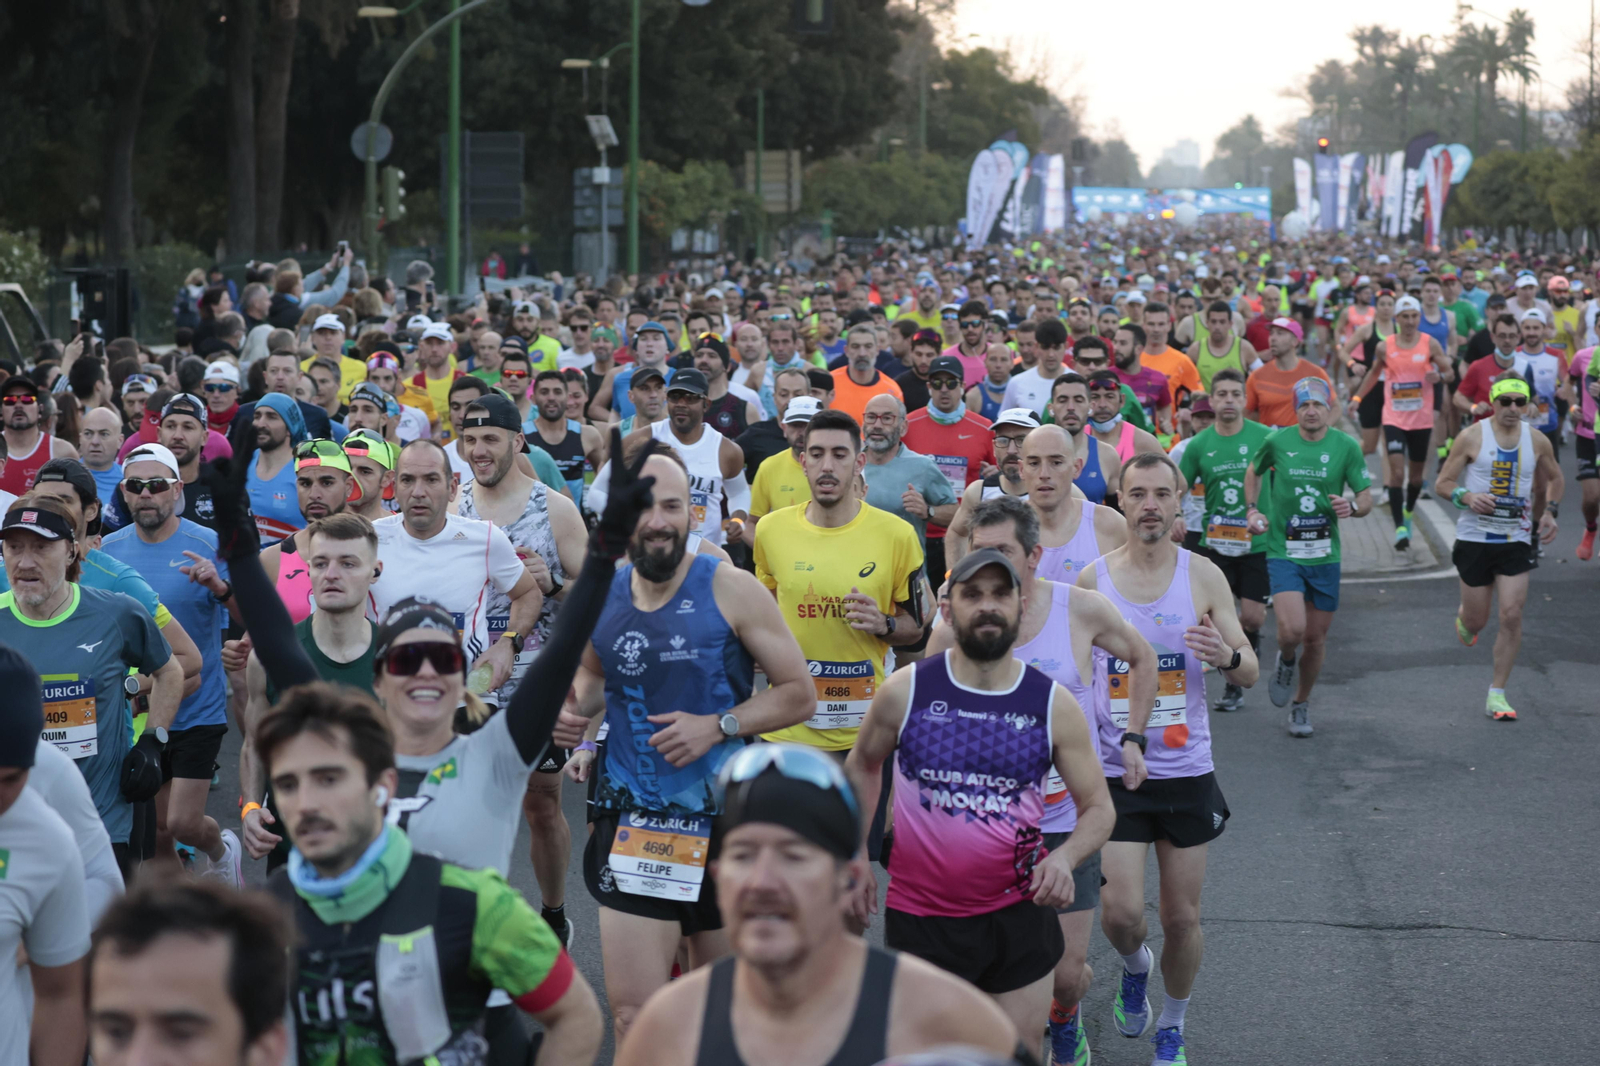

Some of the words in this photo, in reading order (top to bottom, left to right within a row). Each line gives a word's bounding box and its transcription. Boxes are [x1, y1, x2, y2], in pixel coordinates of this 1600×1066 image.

[936, 456, 963, 465] ZURICH
[1211, 462, 1248, 473] SUNCLUB
[1288, 468, 1328, 478] SUNCLUB
[1223, 487, 1239, 505] 8
[1299, 495, 1316, 513] 8
[1300, 518, 1329, 526] ZURICH
[824, 664, 867, 675] ZURICH
[824, 686, 850, 697] 4686
[827, 703, 848, 712] DANI
[957, 709, 987, 720] luanvi
[920, 768, 963, 784] CLUB
[931, 789, 1012, 813] MOKAY
[648, 817, 700, 832] ZURICH
[642, 840, 674, 857] 4690
[636, 861, 673, 876] FELIPE
